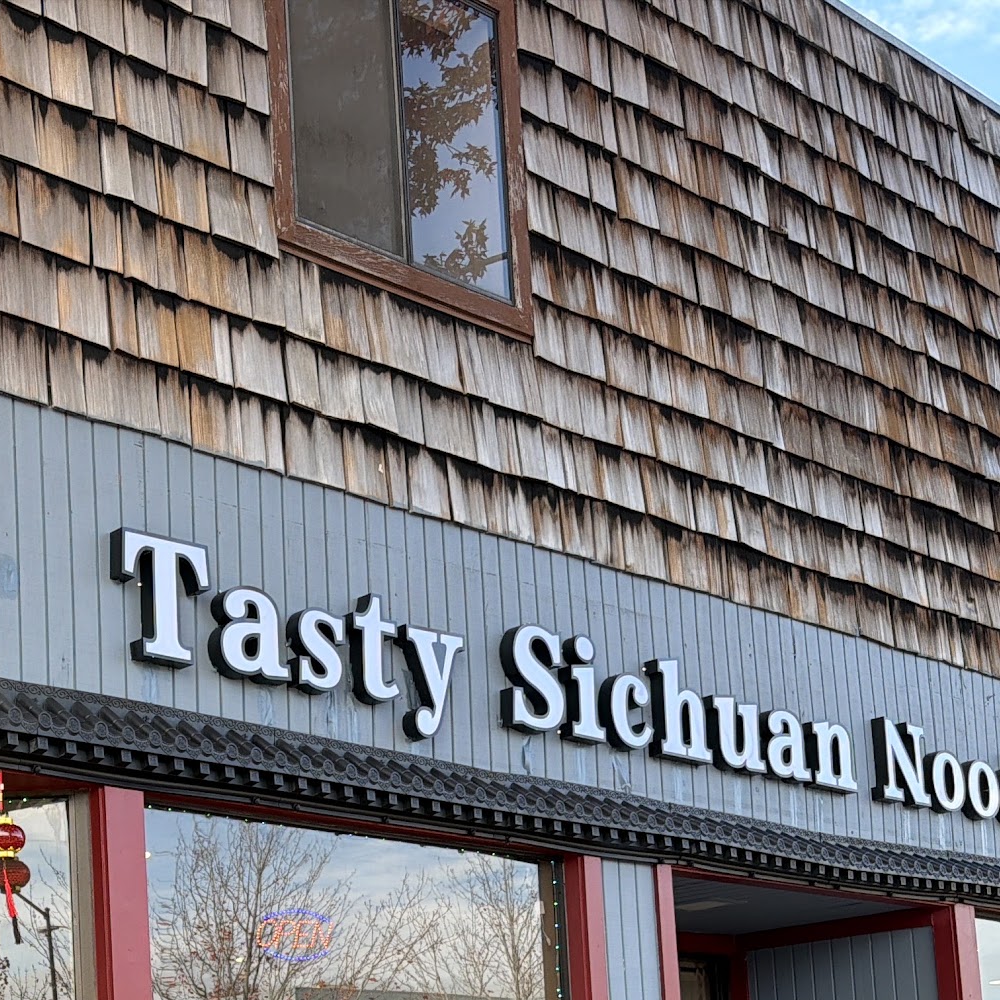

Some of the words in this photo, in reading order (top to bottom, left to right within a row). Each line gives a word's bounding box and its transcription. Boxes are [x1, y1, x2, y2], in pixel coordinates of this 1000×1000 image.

[110, 527, 466, 741] Tasty
[500, 624, 859, 795] Sichuan
[871, 716, 1000, 822] Noo
[256, 918, 335, 950] OPEN
